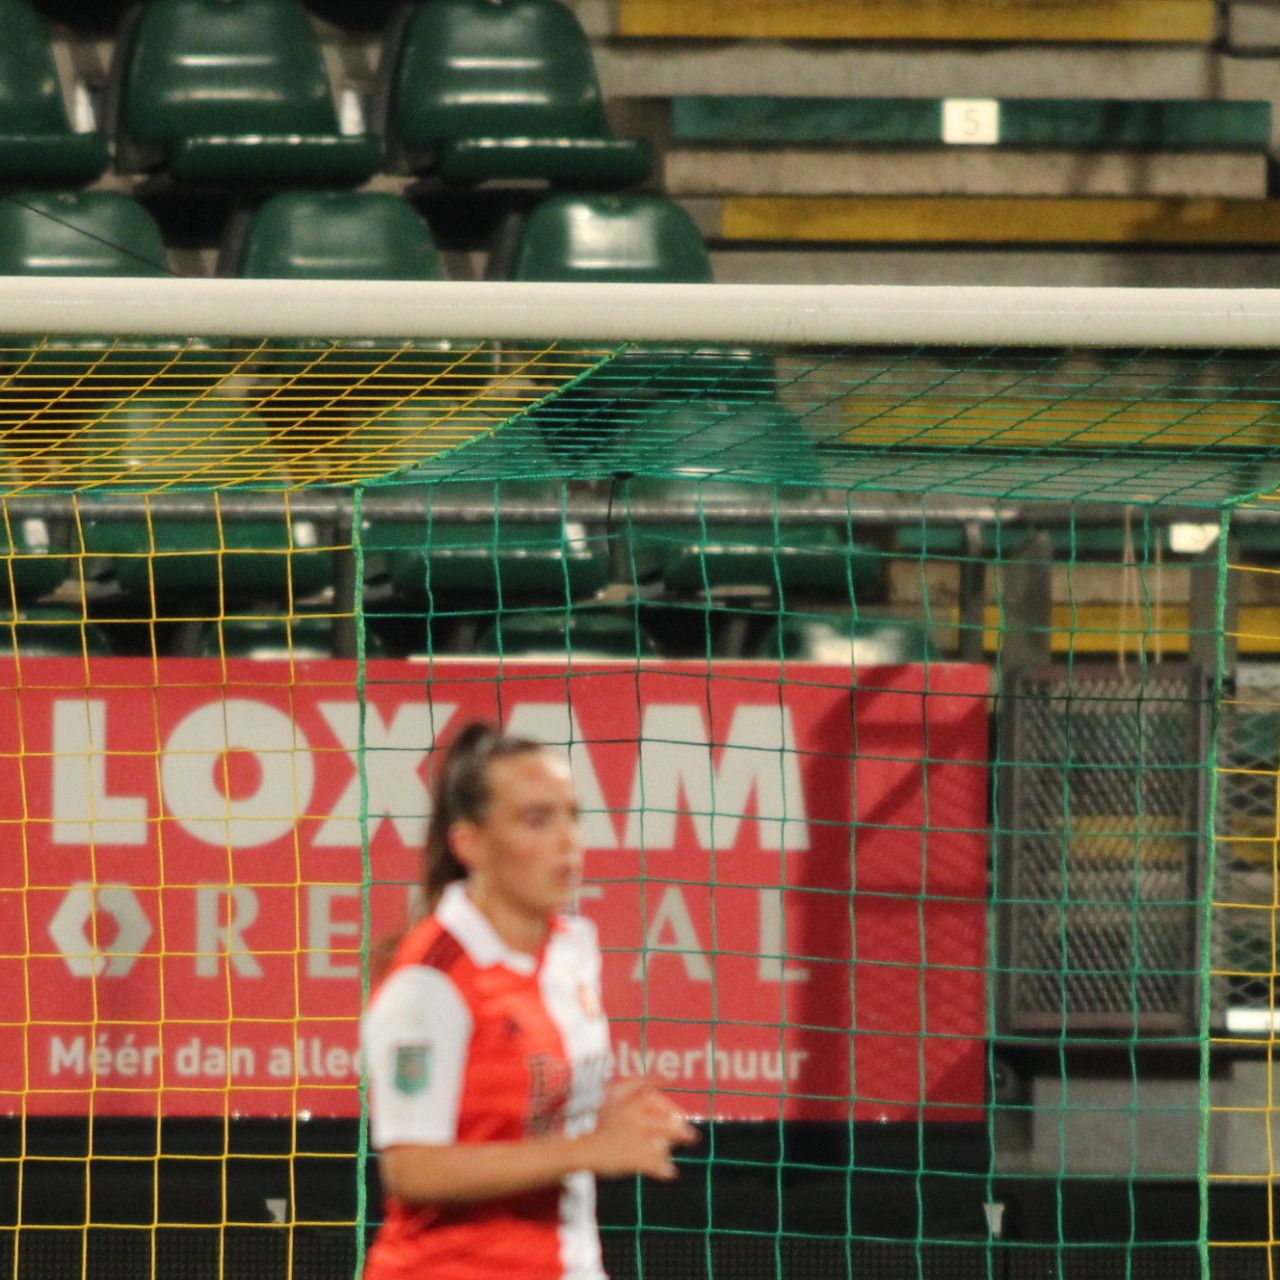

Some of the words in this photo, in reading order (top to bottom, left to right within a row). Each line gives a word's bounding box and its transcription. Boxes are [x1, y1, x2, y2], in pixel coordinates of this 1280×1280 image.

[195, 882, 811, 983] REAL
[50, 1034, 159, 1076] Méér
[175, 1037, 256, 1077] dan
